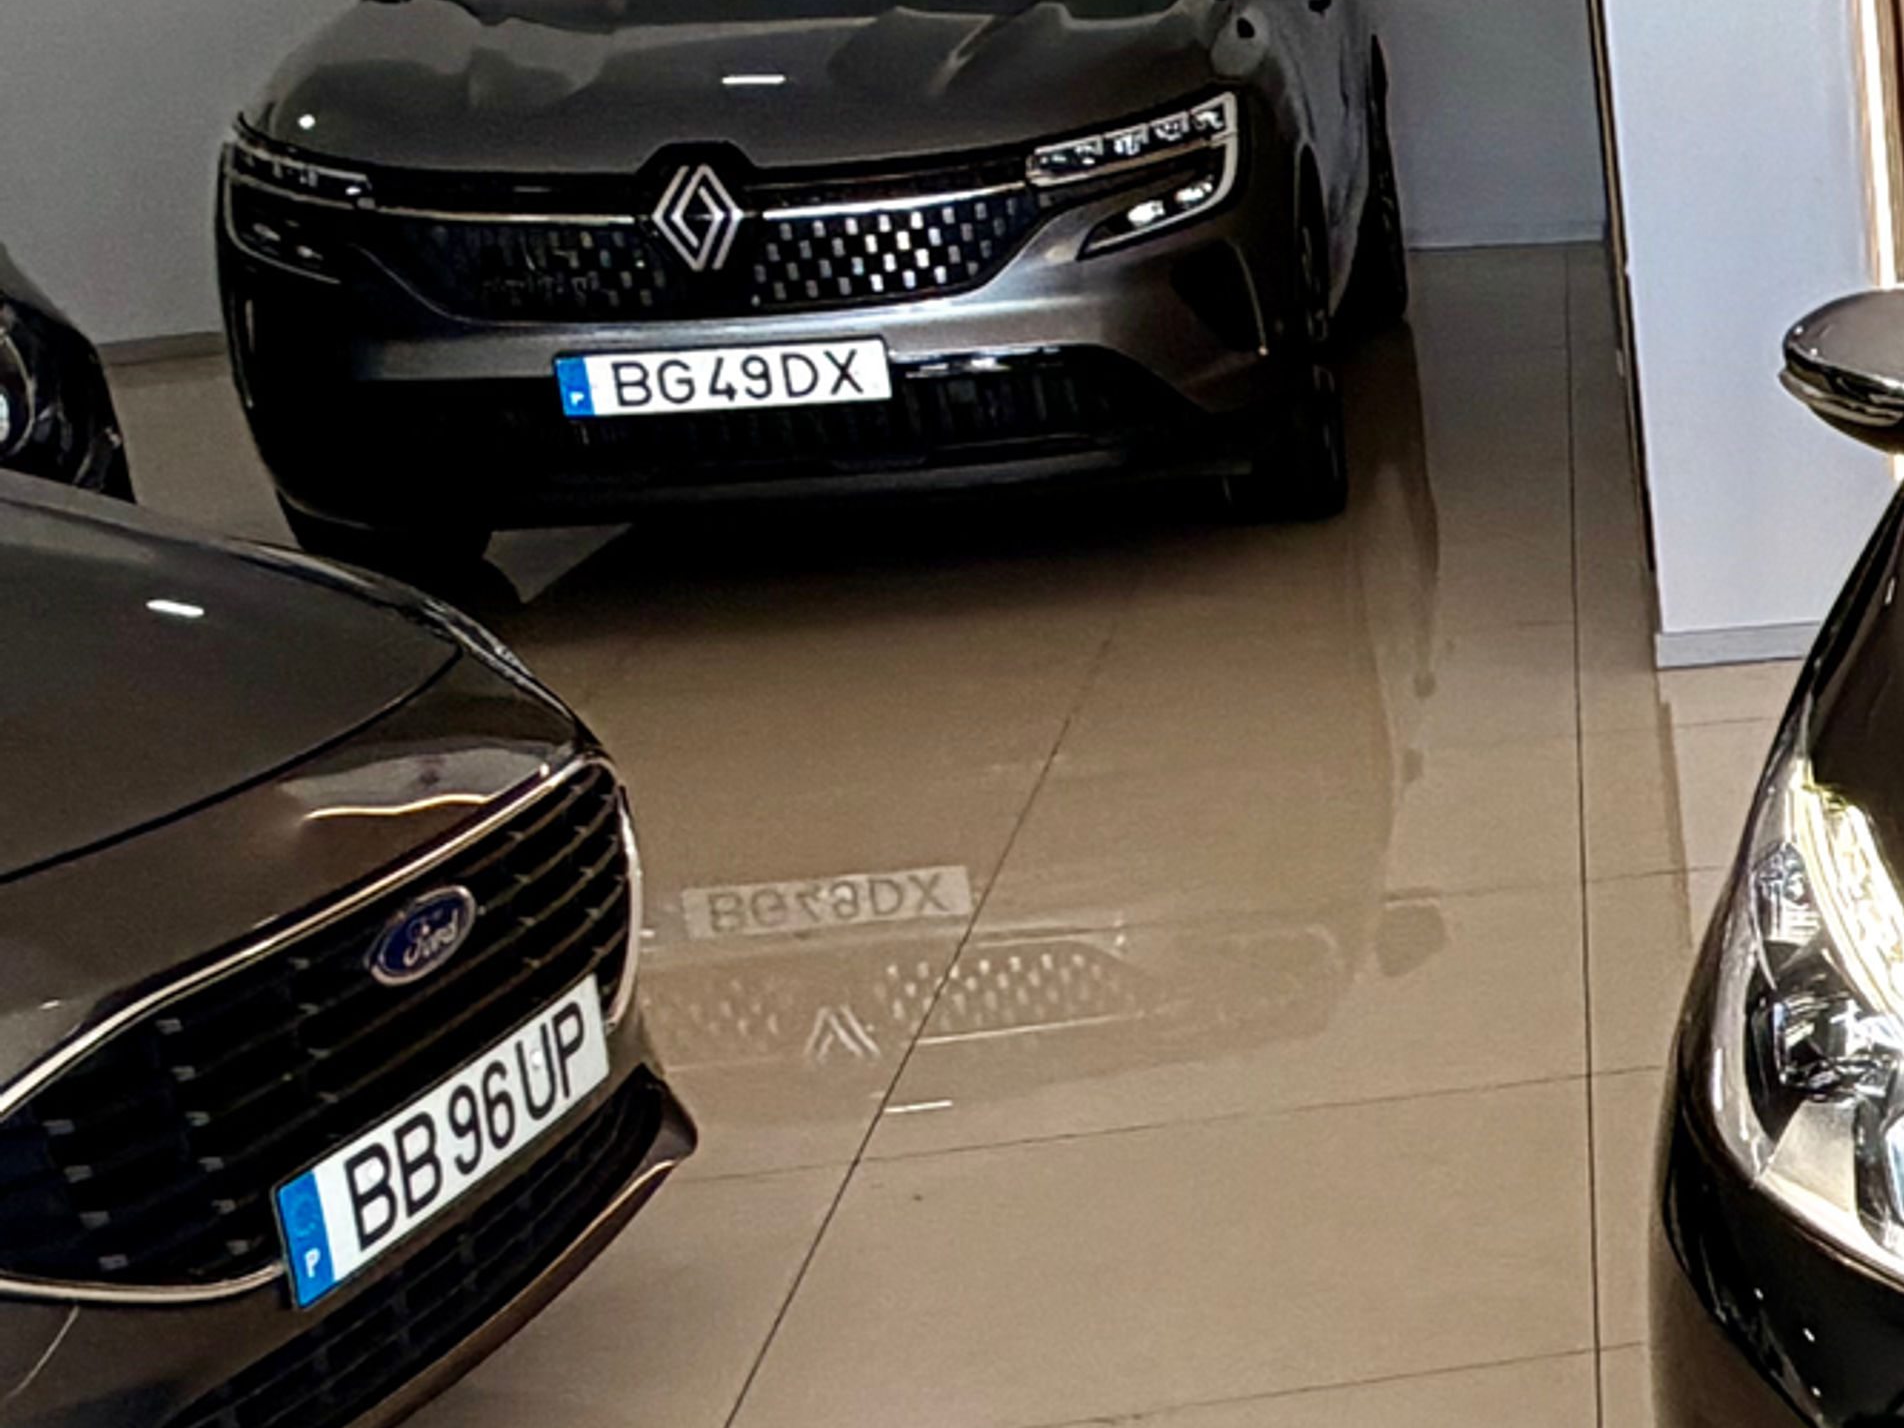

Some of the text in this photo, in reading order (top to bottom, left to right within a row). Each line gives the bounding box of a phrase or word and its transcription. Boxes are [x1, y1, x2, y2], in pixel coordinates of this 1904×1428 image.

[611, 349, 864, 408] BG49DX
[403, 908, 459, 967] Ford
[304, 1001, 585, 1279] P BB96UP
